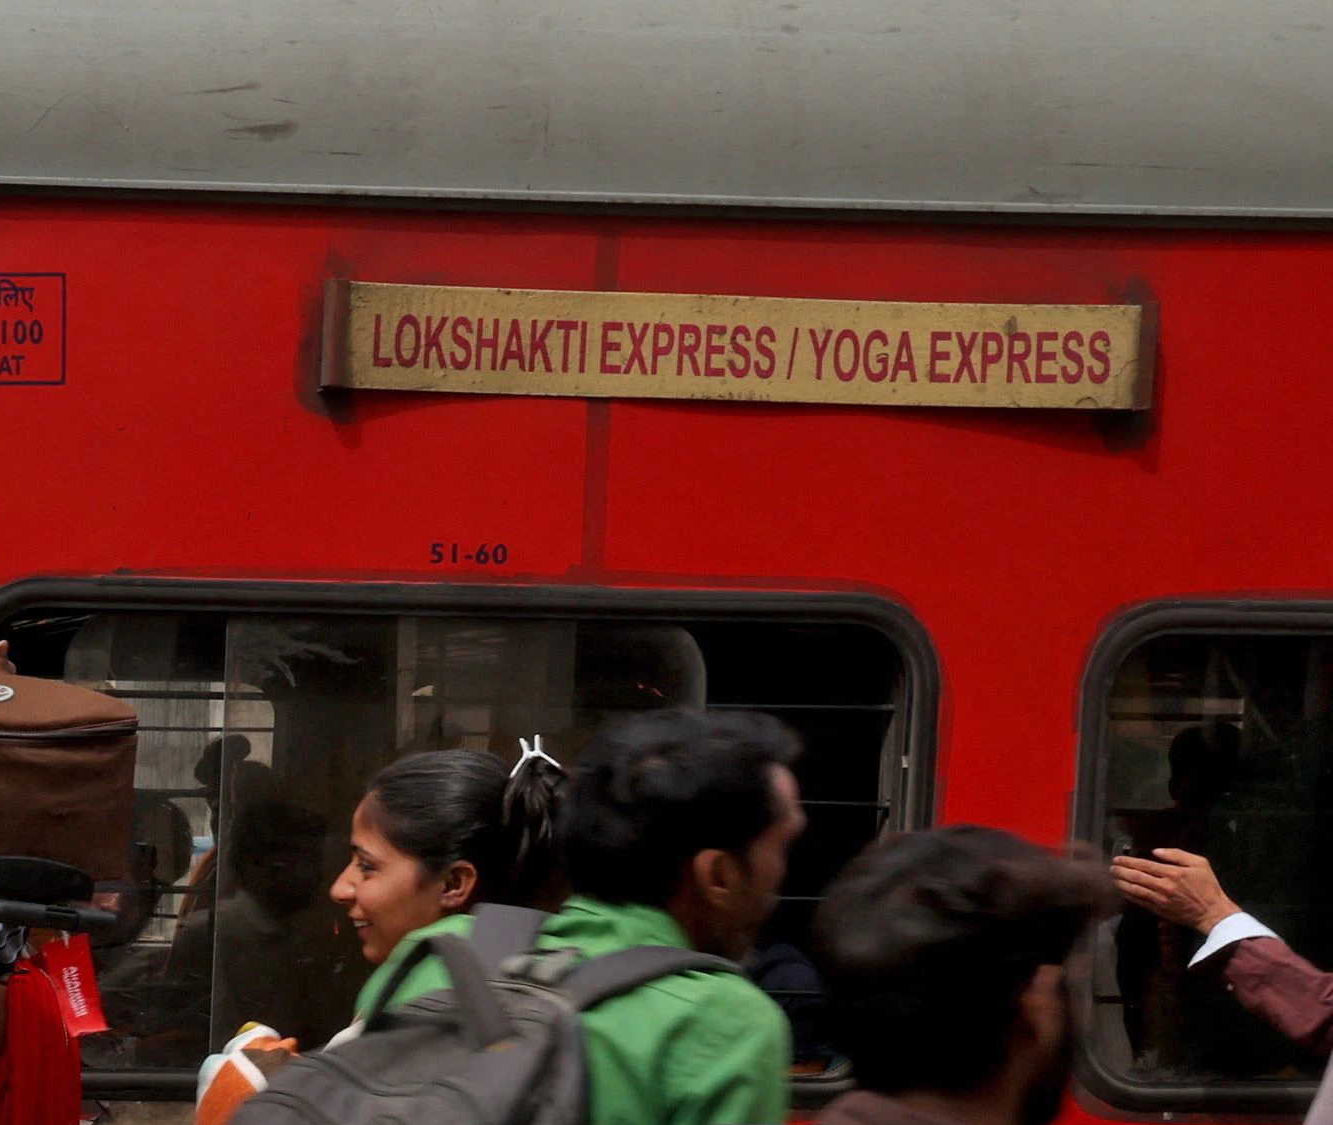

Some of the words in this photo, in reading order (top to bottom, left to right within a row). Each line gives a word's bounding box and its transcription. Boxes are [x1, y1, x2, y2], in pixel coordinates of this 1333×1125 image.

[1, 320, 44, 344] 100
[371, 313, 587, 373] LOKSHAKTI
[599, 320, 776, 379] EXPRESS
[809, 328, 918, 384] YOGA
[930, 329, 1112, 385] EXPRESS
[429, 543, 508, 565] 51-60
